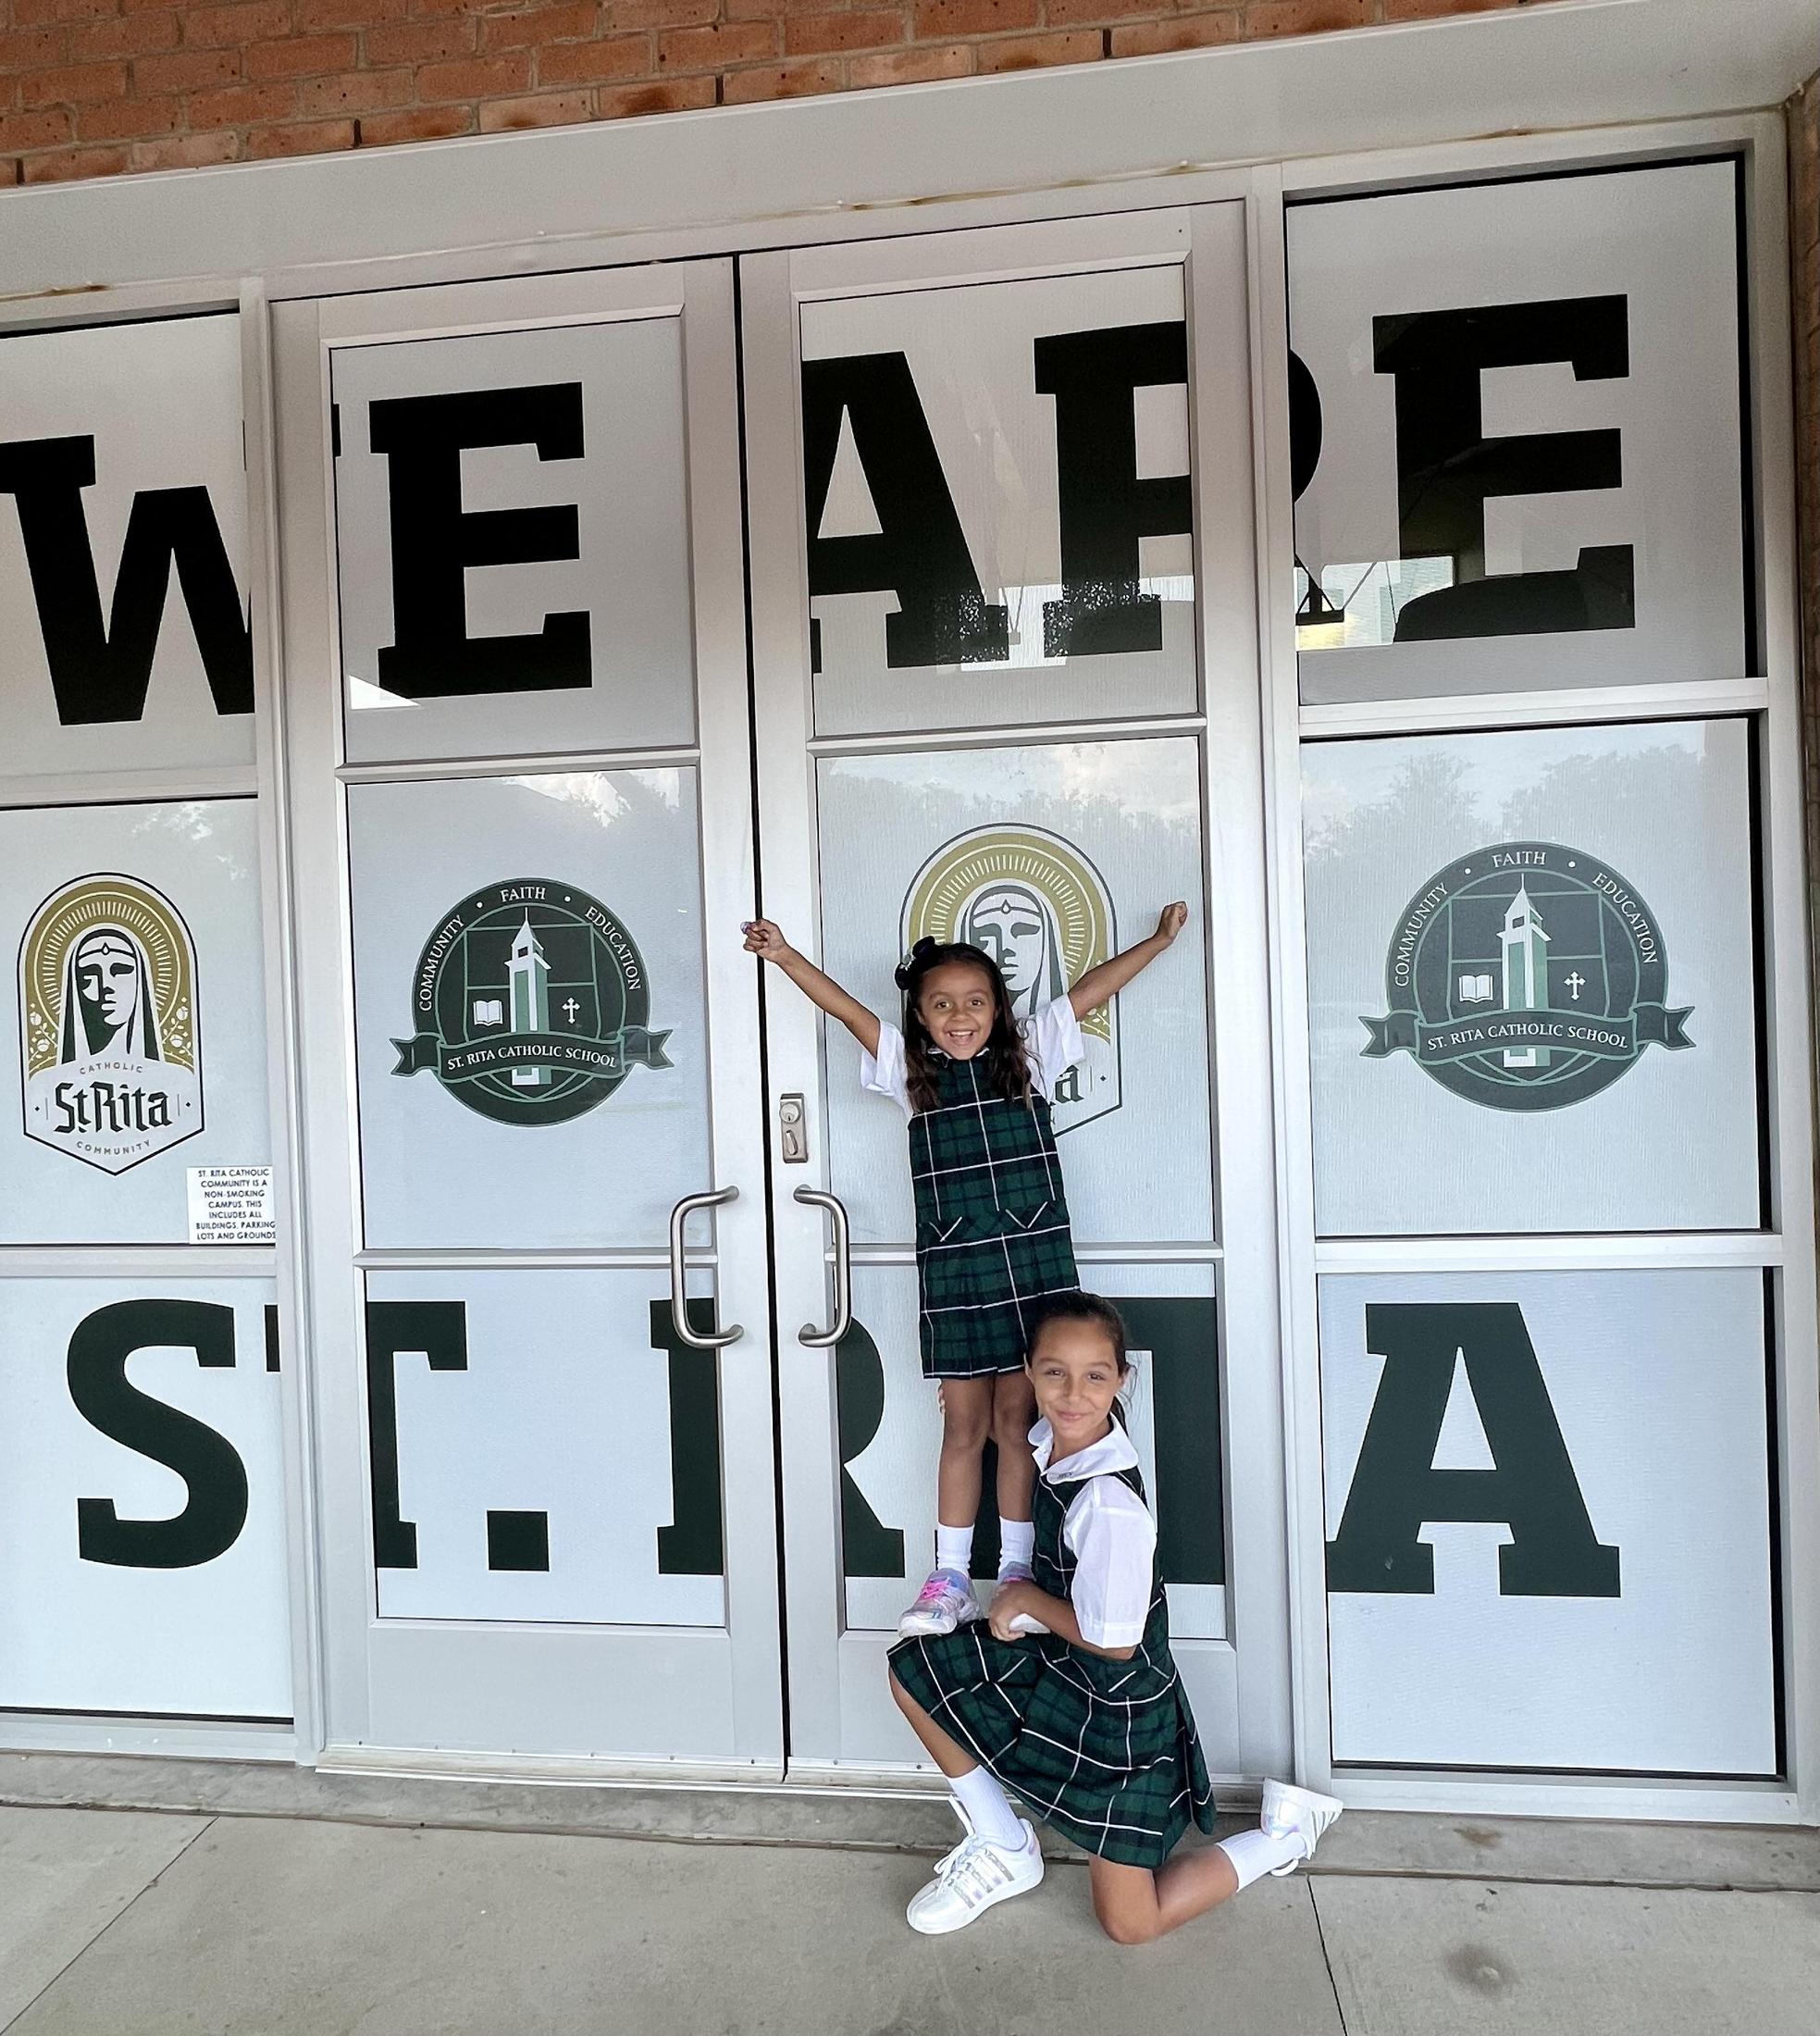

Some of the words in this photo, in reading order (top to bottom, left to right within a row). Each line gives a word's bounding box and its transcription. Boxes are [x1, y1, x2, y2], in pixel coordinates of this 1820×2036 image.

[0, 381, 593, 726] WE
[801, 294, 1636, 674] ARE
[1395, 882, 1449, 987] COMMUNITY
[1492, 851, 1546, 867] FAITH
[1592, 873, 1658, 963] EDUCATION
[418, 915, 464, 1012] COMMUNITY
[500, 887, 546, 902] FAITH
[584, 906, 641, 990] EDUCATION
[1428, 1036, 1448, 1050] ST.
[1452, 1027, 1485, 1044] RITA
[1488, 1023, 1564, 1037] CATHOLIC
[1567, 1025, 1628, 1049] SCHOOL
[80, 1061, 143, 1074] CATHOLIC
[447, 1056, 464, 1071] ST.
[466, 1049, 496, 1064] RITA
[498, 1045, 562, 1057] CATHOLIC
[565, 1048, 617, 1068] SCHOOL
[76, 1139, 151, 1155] COMMUNITY
[241, 1221, 276, 1229] PARKING
